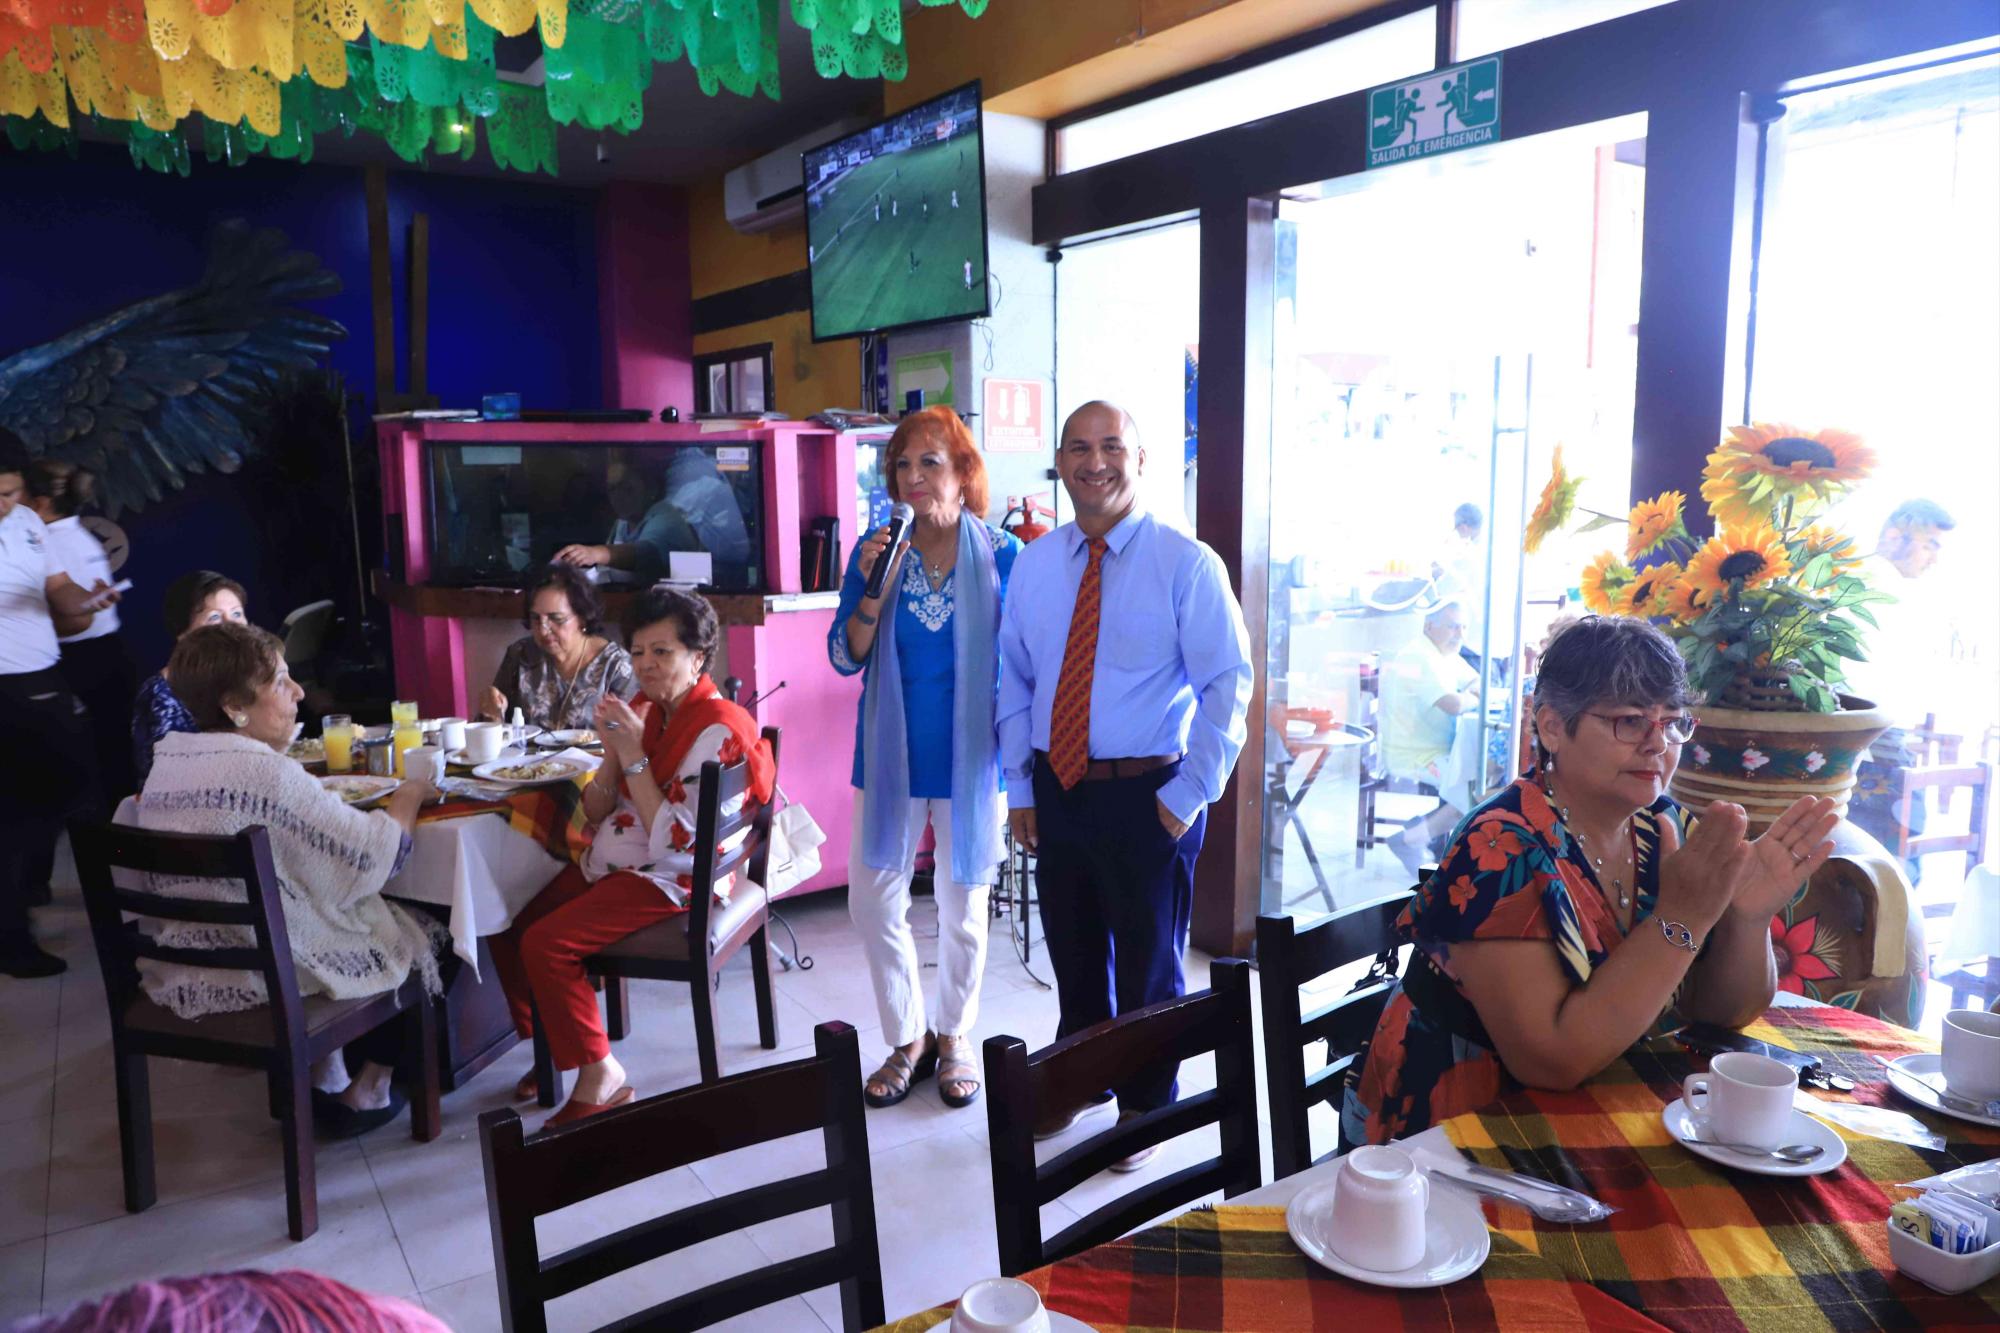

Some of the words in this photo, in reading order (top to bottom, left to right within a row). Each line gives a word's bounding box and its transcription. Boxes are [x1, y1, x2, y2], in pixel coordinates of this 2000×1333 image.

[1371, 147, 1406, 165] SALIDA
[1408, 143, 1421, 156] DE
[1424, 127, 1492, 152] EMERGENCIA
